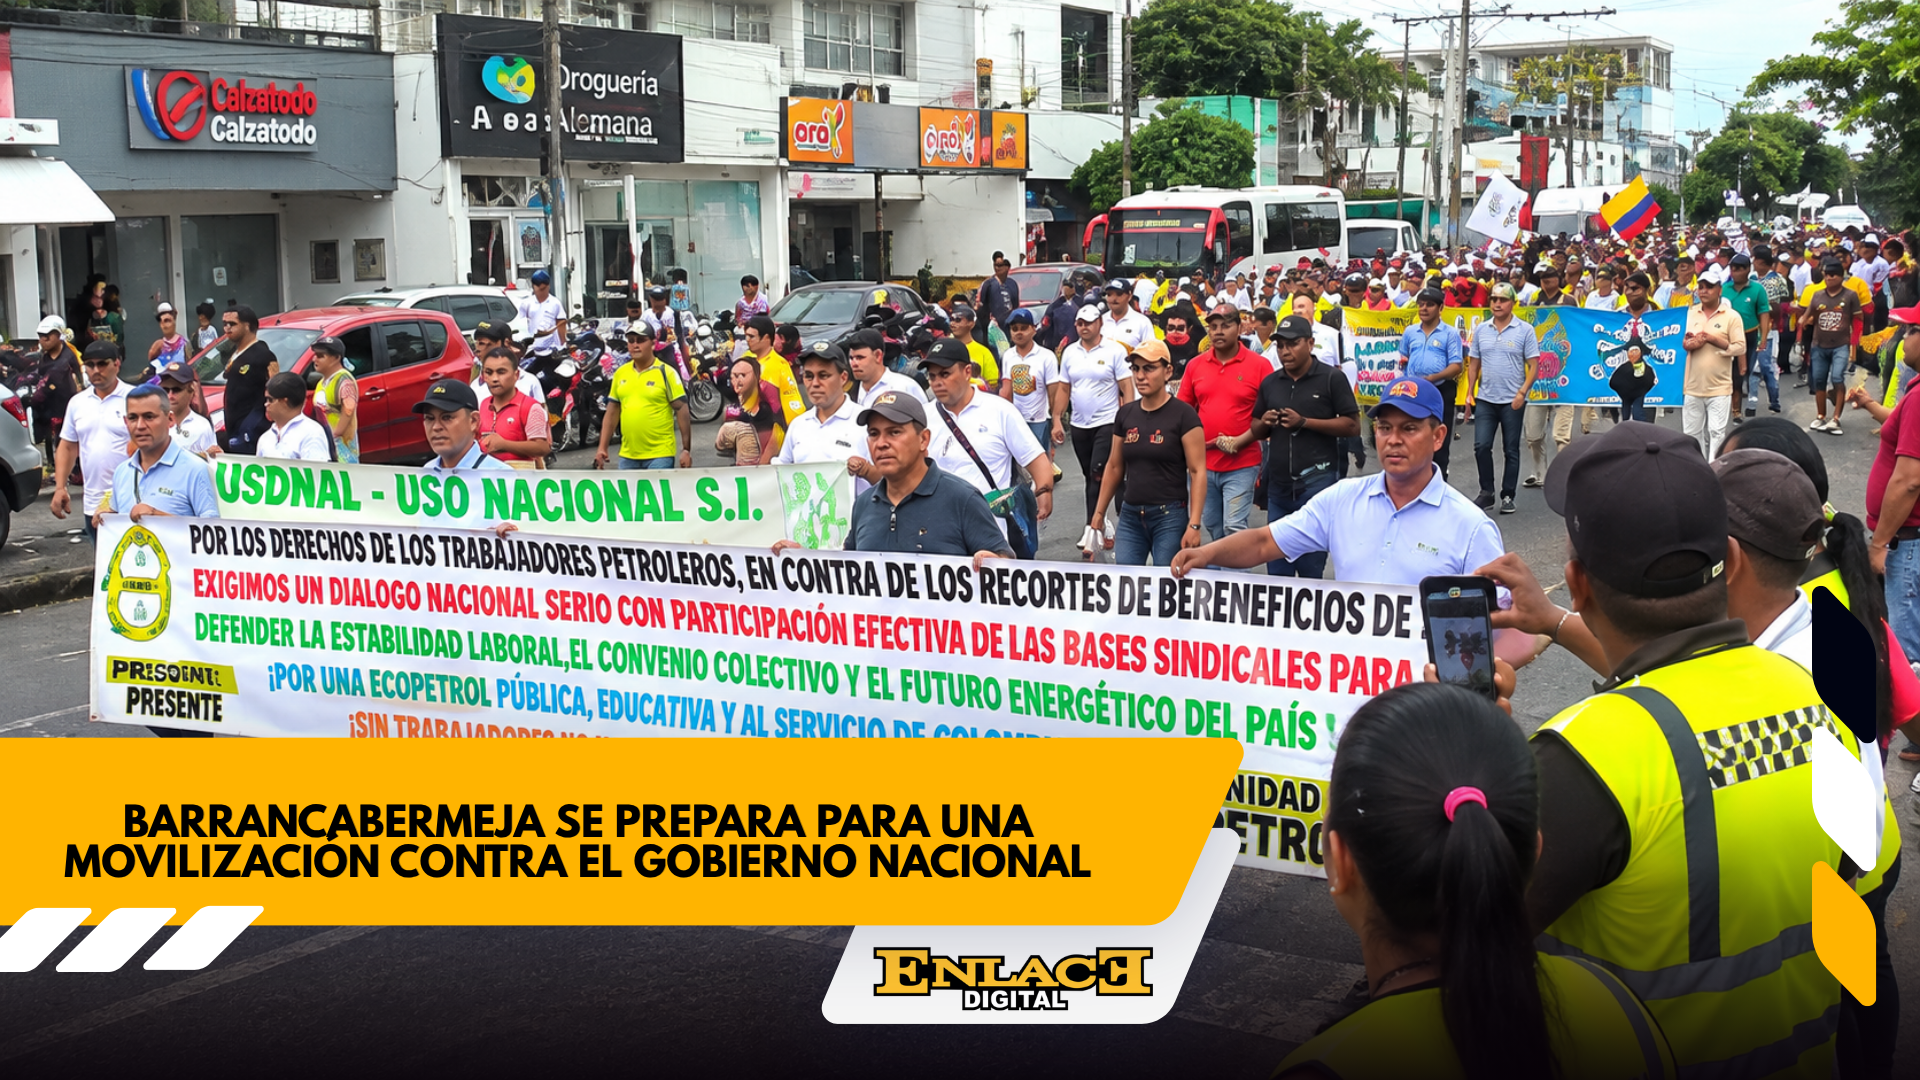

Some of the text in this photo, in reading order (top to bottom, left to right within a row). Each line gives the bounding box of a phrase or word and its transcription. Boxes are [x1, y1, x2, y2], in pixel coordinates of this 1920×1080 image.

[211, 77, 318, 116] Calzatodo
[559, 63, 658, 99] Droguería
[211, 115, 317, 145] Calzatodo
[559, 106, 653, 136] Alemana
[215, 461, 361, 512] USDNAL
[394, 473, 470, 518] USO
[481, 477, 684, 522] NACIONAL
[695, 476, 764, 522] S.I.
[189, 524, 1412, 639] POR LOS DERECHOS DE LOS TRABAJADORES PETROLEROS, EN CONTRA DE LOS RECORTES DE BERENEFICIOS DE
[193, 568, 1413, 697] EXIGIMOS UN DIALOGO NACIONAL SERIO CON PARTICIPACIÓN EFECTIVA DE LAS BASES SINDICALES PARA
[126, 686, 222, 722] PRESENTE
[195, 612, 295, 648] DEFENDER
[300, 619, 325, 649] LA
[331, 621, 463, 660] ESTABILIDAD
[597, 640, 708, 681] CONVENIO
[713, 650, 839, 695] COLECTIVO
[844, 663, 860, 697] Y
[867, 666, 894, 700] EL
[900, 668, 1001, 711] FUTURO
[1008, 678, 1177, 733] ENERGÉTICO
[1185, 698, 1238, 739] DEL
[1246, 700, 1317, 751] PAÍS
[320, 666, 366, 697] UNA
[370, 669, 491, 707] ECOPETROL
[496, 673, 593, 721] PÚBLICA,
[597, 688, 716, 732] EDUCATIVA
[721, 700, 737, 735] Y
[741, 704, 768, 737] AL
[775, 707, 886, 738] SERVICIO
